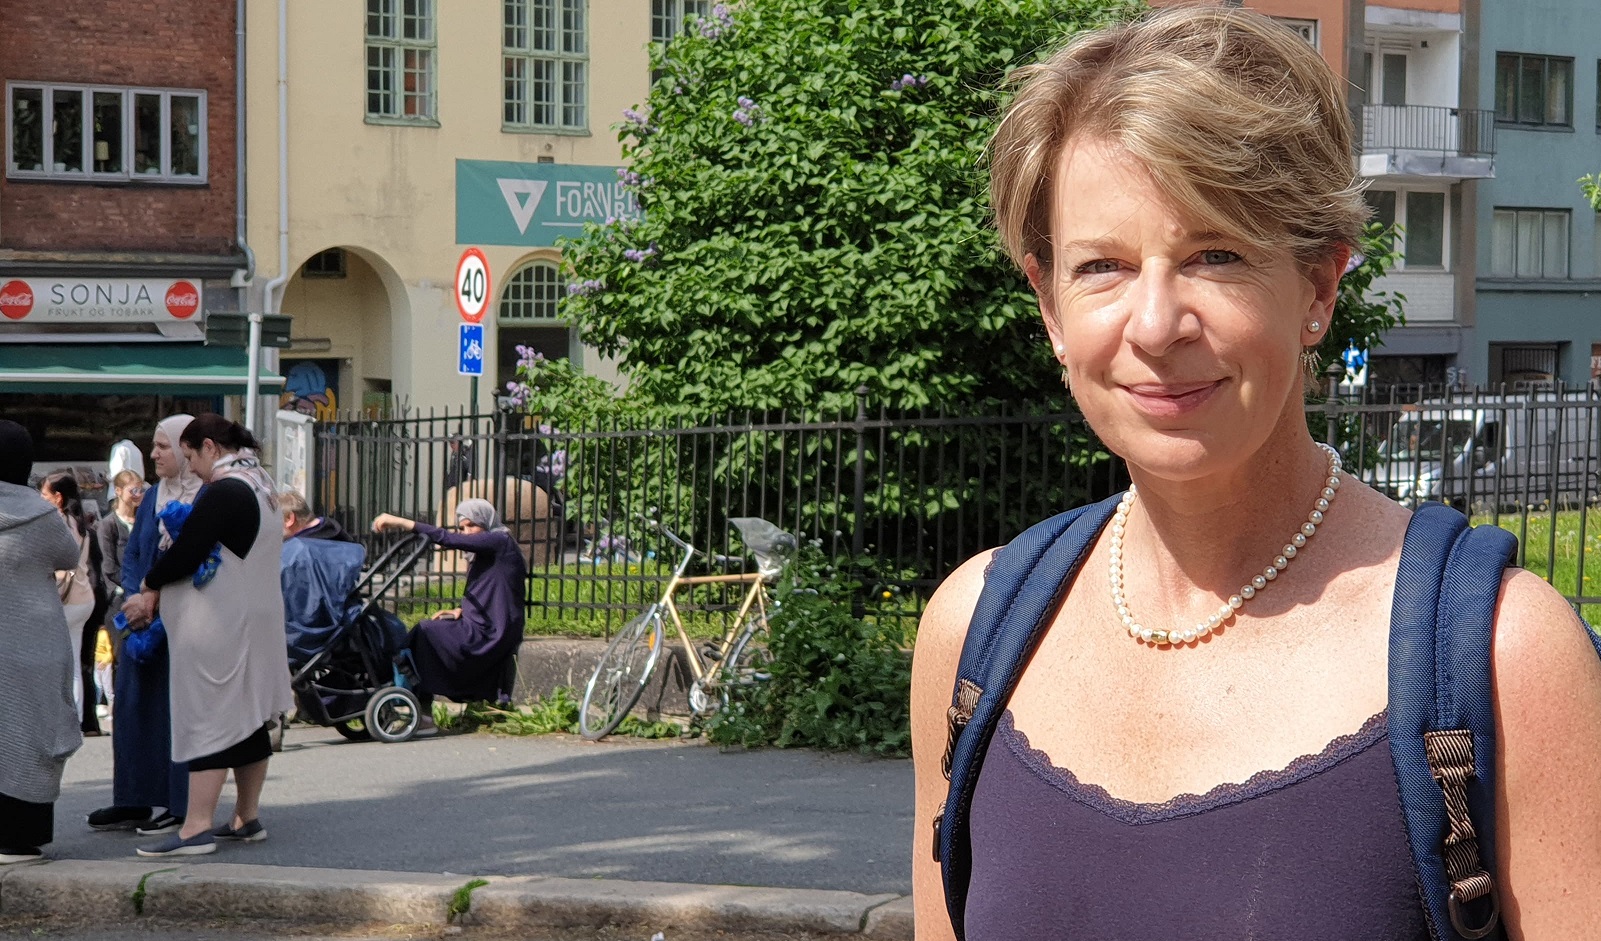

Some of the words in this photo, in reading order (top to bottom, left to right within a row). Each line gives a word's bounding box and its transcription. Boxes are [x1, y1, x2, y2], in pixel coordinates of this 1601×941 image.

[51, 283, 152, 305] SONJA
[461, 268, 484, 303] 40
[48, 308, 84, 317] FRUKT
[88, 308, 105, 317] OG
[111, 308, 154, 317] TOBAKK
